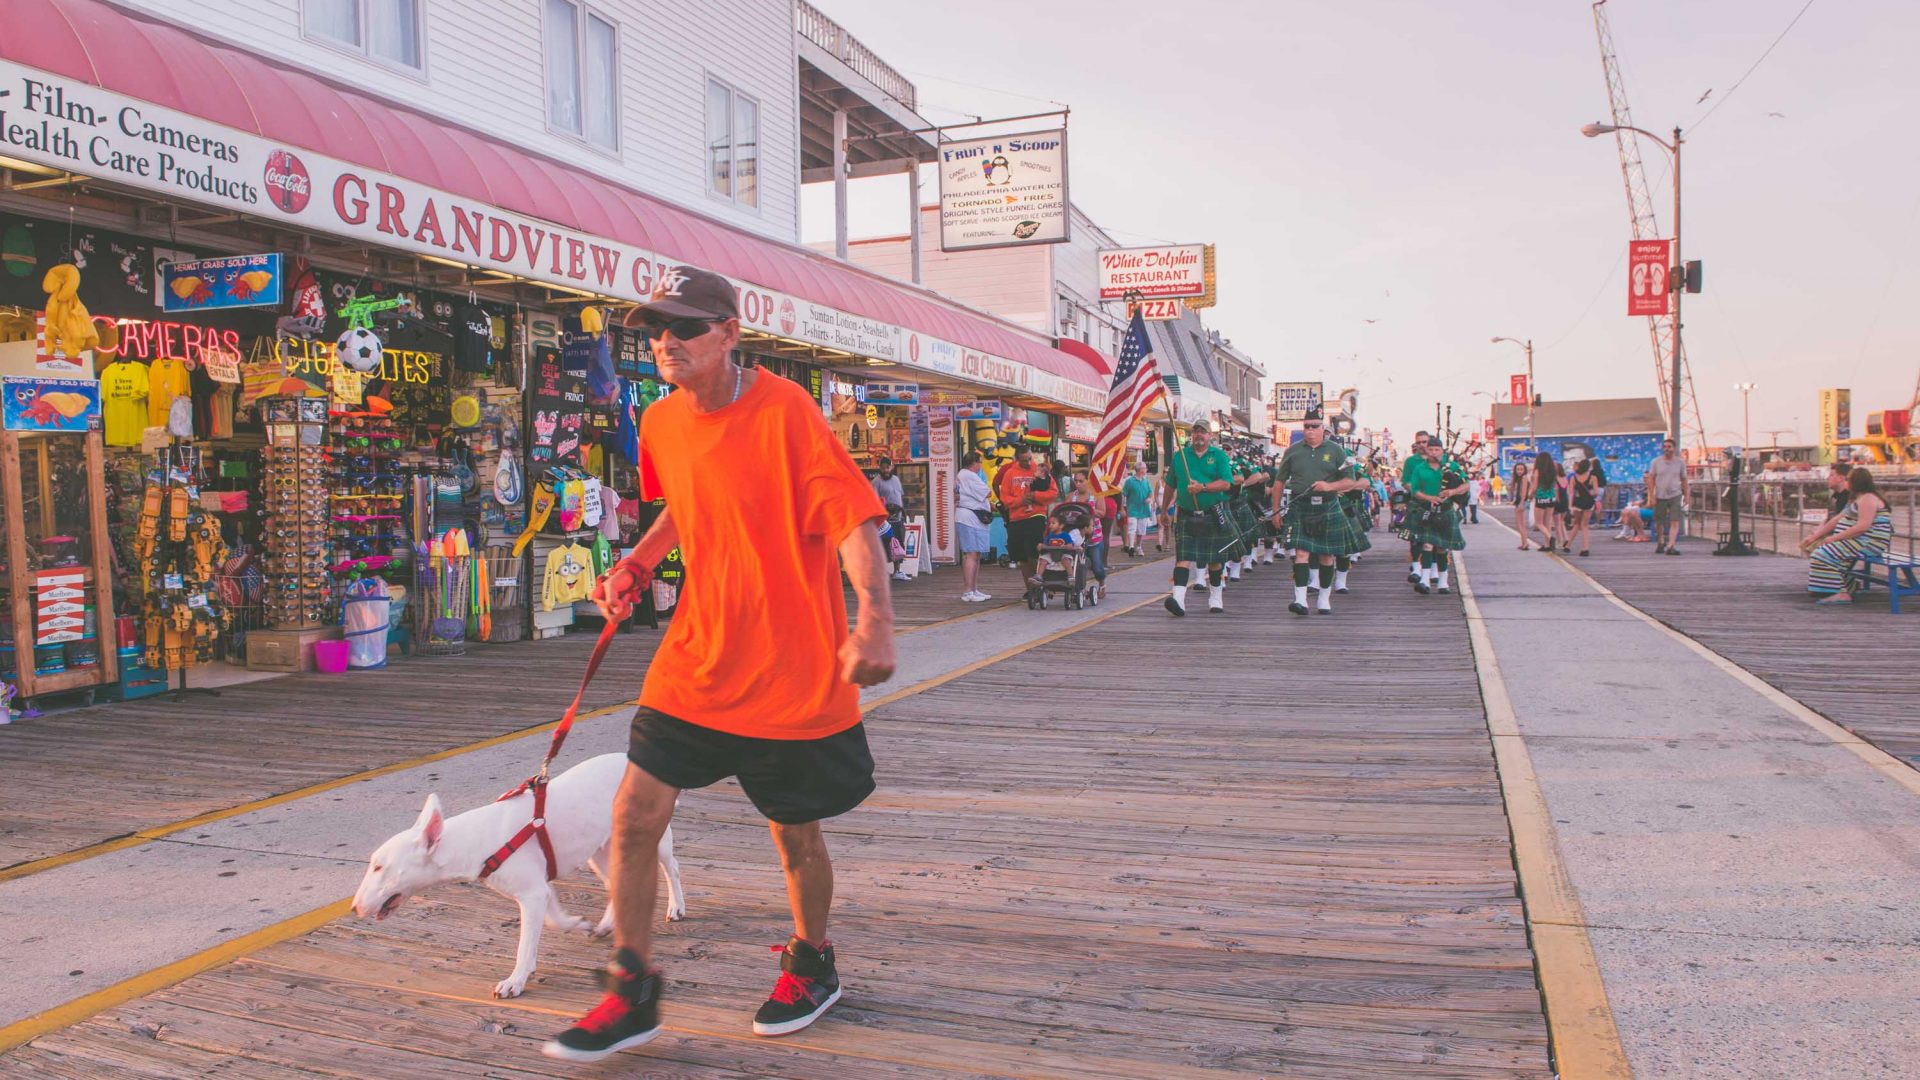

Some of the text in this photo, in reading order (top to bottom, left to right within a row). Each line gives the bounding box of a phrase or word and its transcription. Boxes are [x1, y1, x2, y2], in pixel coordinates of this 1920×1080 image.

[118, 106, 239, 163] Cameras
[943, 140, 1060, 162] FRUIT N SCOOP
[89, 136, 150, 176] Care
[158, 152, 258, 204] Products
[1020, 160, 1052, 173] SMOOTHIES
[943, 188, 1009, 199] PHILADELPHIA
[1011, 184, 1045, 193] WATER
[943, 201, 1063, 218] ORIGINAL STYLE FUNNEL CAKES
[952, 194, 1054, 209] TORNADO FRIES
[333, 173, 621, 289] GRANDVIEW
[1637, 244, 1662, 253] enjoy
[173, 255, 268, 272] HERMIT CRABS SOLD HERE
[1102, 250, 1198, 270] White Dolphin
[1111, 269, 1190, 284] RESTAURANT
[1177, 284, 1197, 292] Dinner
[810, 305, 835, 324] Suntan
[836, 312, 858, 331] Lotion
[863, 319, 890, 339] Seashells
[90, 315, 242, 365] CAMERAS
[802, 321, 895, 358] T-shirts Beach Toys Candy
[980, 353, 1016, 386] CREAM
[1280, 388, 1307, 399] FUDGE
[1782, 448, 1811, 461] EXIT
